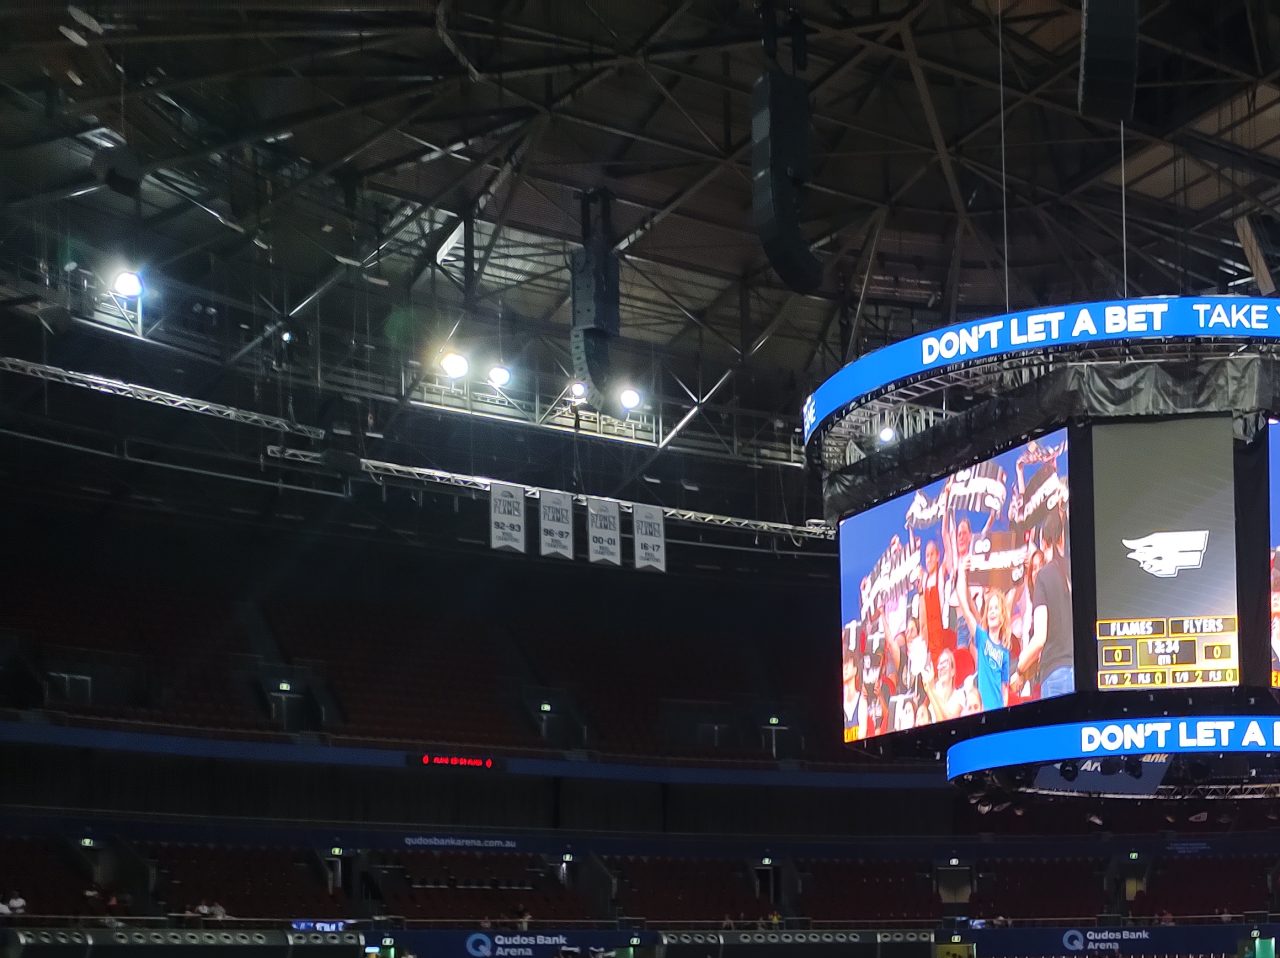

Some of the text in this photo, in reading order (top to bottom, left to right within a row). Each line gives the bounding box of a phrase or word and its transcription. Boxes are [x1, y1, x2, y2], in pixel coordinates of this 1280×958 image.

[922, 320, 1003, 364] DON'T
[1010, 312, 1065, 345] LET
[1072, 308, 1097, 337] A
[1105, 303, 1168, 334] BET
[1193, 304, 1269, 329] TAKE
[494, 521, 521, 532] 92-93
[543, 528, 570, 539] 96-97
[592, 536, 616, 545] 00-01
[640, 543, 660, 552] 16-17
[1110, 621, 1153, 636] FLAMES
[1183, 619, 1223, 633] FLYERS
[1114, 649, 1122, 662] 0
[1213, 646, 1221, 659] 0
[1123, 673, 1131, 685] 2
[1154, 672, 1162, 684] 0
[1195, 670, 1203, 683] 2
[1225, 669, 1233, 682] 0
[1081, 722, 1171, 752] DON'T
[1178, 721, 1235, 747] LET
[1242, 720, 1266, 747] A
[404, 837, 517, 848] qudosbankarena.com.au
[495, 935, 568, 945] Qudos Bank
[1086, 930, 1149, 940] Qudos Bank
[496, 946, 533, 956] Arena
[1087, 941, 1119, 950] Arena
